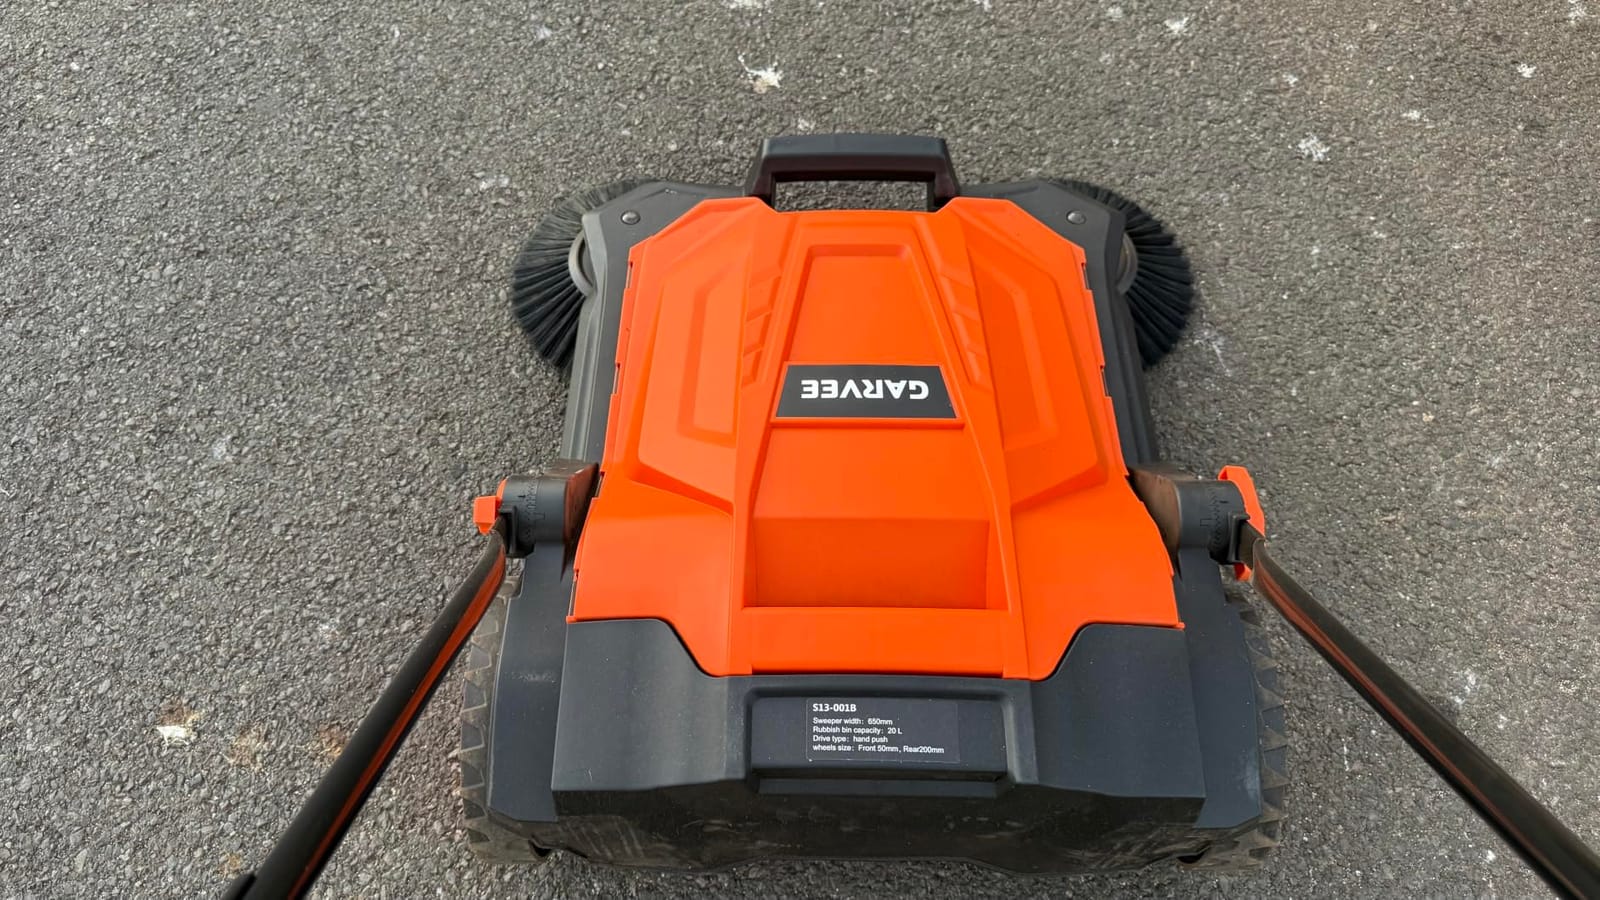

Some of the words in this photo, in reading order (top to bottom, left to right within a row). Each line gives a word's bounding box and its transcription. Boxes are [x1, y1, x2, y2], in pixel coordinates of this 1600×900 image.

[800, 379, 929, 400] GARVEE
[813, 704, 856, 712] S13-001B
[854, 726, 883, 735] capacity:
[853, 735, 870, 743] hand
[872, 736, 888, 744] push
